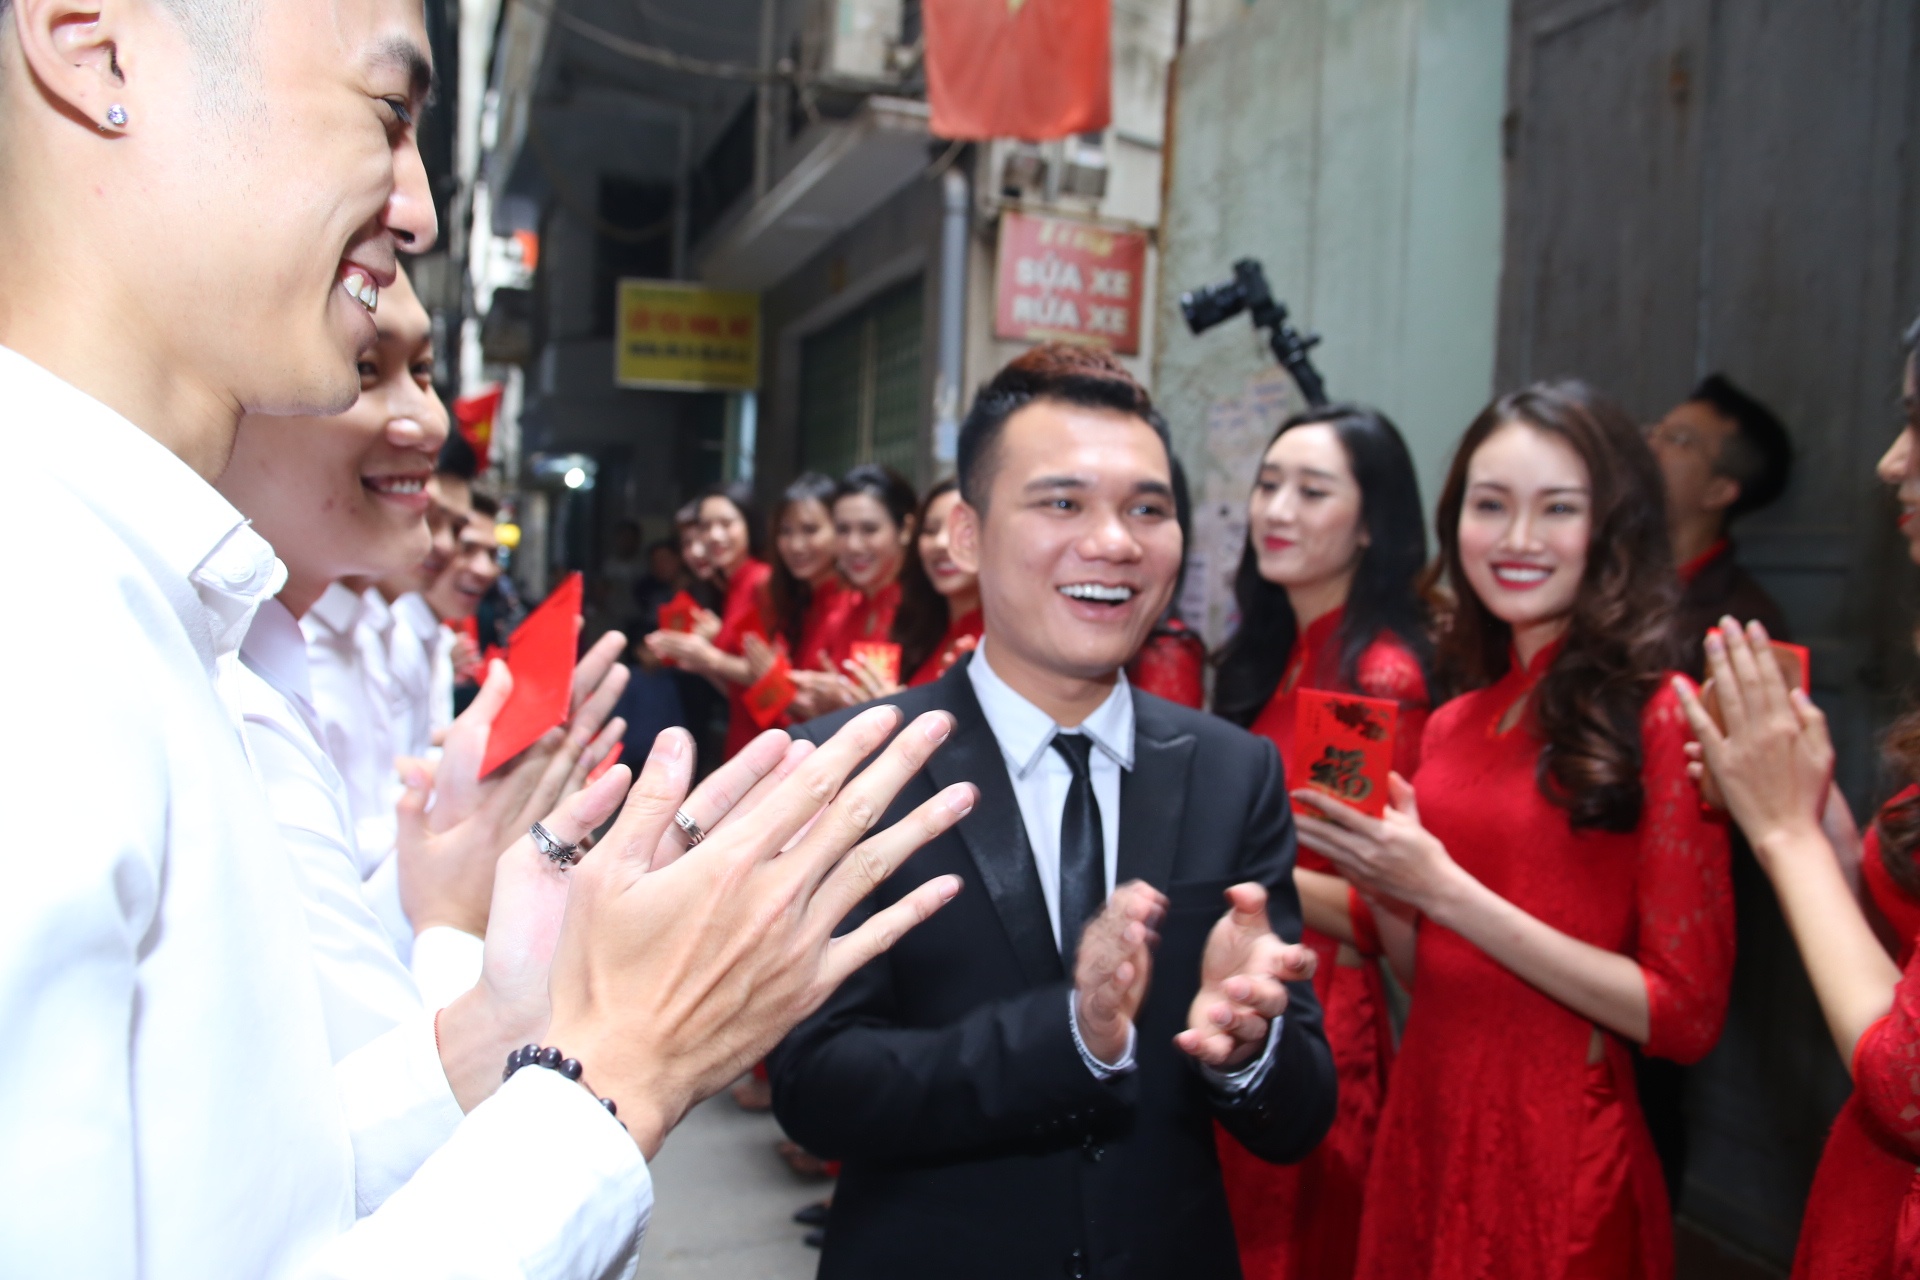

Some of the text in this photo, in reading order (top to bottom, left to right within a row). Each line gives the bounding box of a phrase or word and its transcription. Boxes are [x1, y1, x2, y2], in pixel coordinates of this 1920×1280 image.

[1015, 251, 1131, 298] SỬA XE
[1087, 304, 1128, 335] XE
